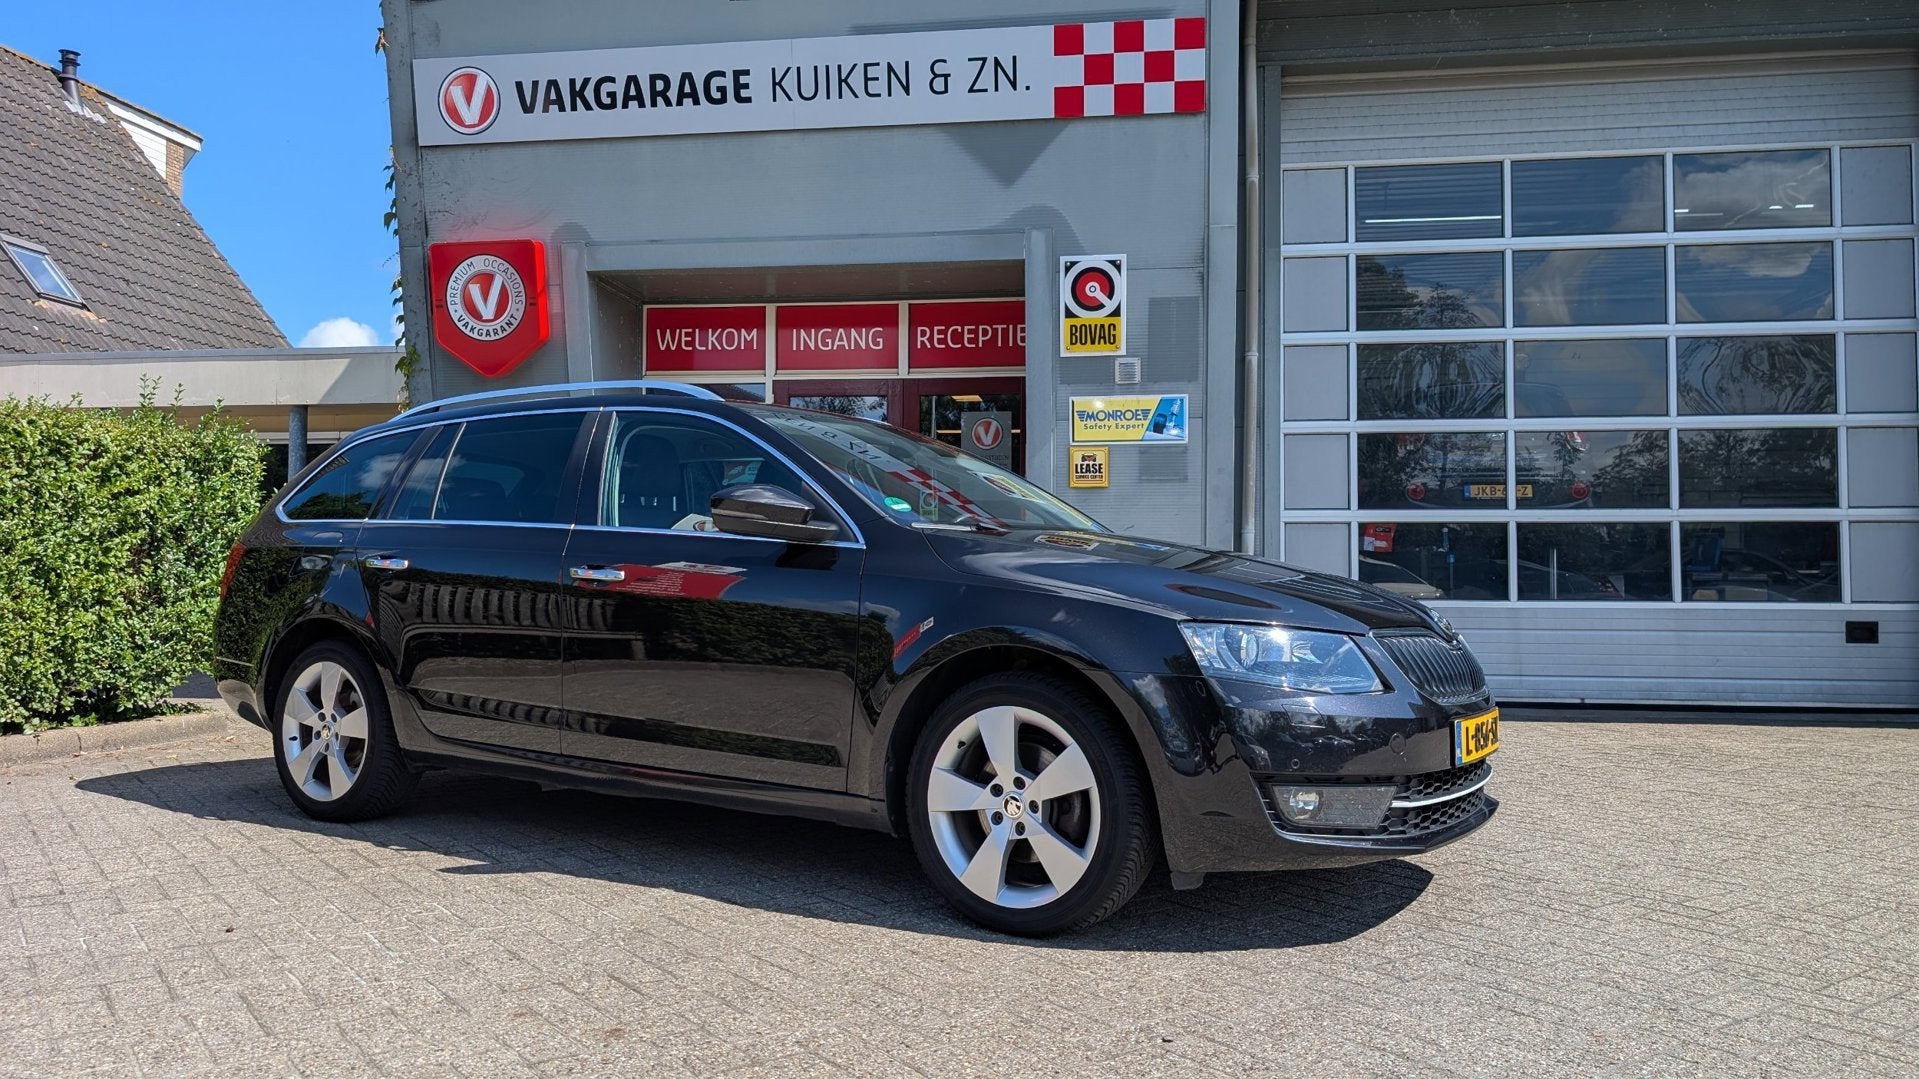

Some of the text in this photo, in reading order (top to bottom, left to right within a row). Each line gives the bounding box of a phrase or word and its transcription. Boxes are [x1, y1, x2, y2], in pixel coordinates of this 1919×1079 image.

[515, 55, 1031, 114] VAKGARAGE KUIKEN & ZN.
[450, 258, 523, 306] PREMIUM OCCASIONS
[457, 314, 518, 338] VAKGARANT
[917, 324, 1026, 349] RECEPTIE
[1070, 323, 1116, 346] BOVAG
[656, 328, 758, 351] WELKOM
[792, 327, 884, 351] INGANG
[1083, 422, 1144, 431] Safety Expert
[1085, 409, 1143, 422] MONROE
[1075, 463, 1103, 474] LEASE
